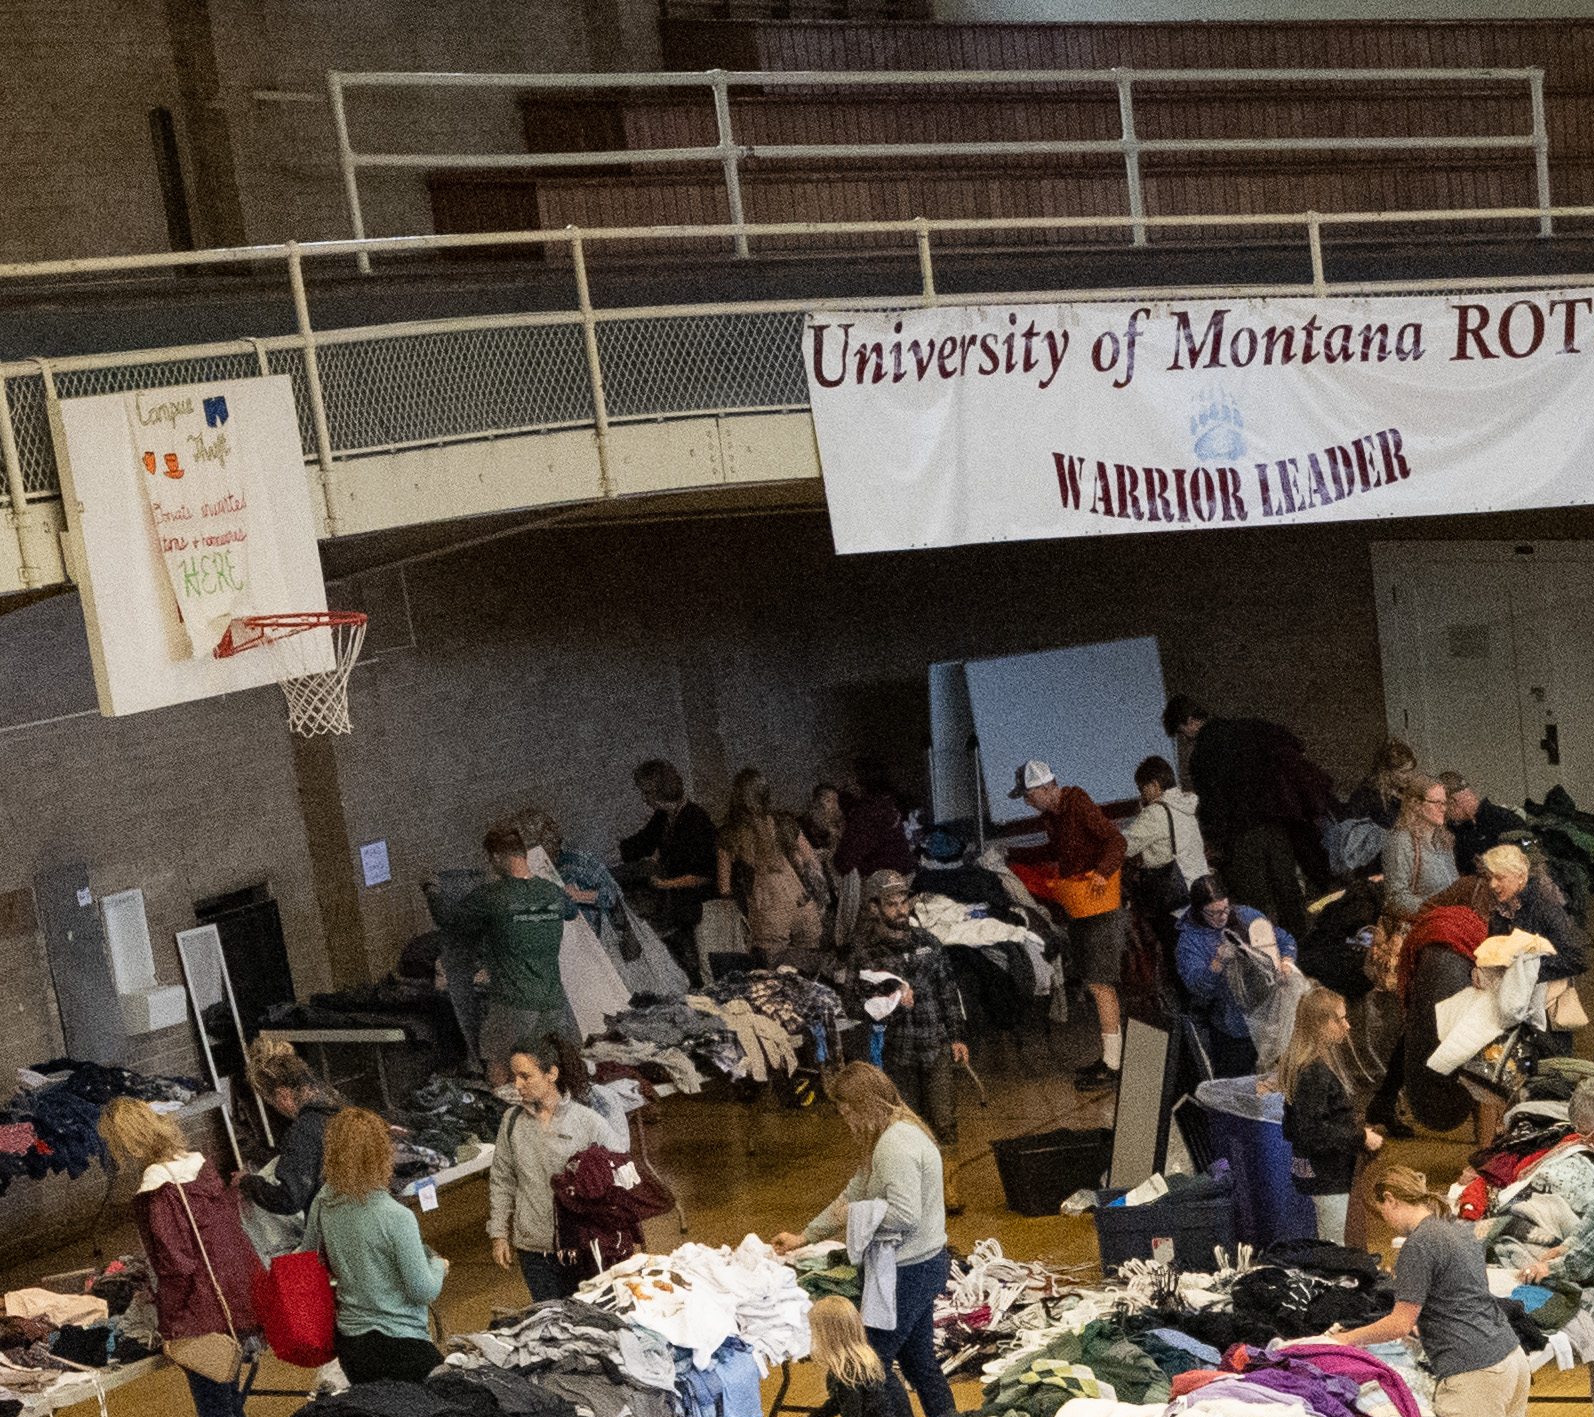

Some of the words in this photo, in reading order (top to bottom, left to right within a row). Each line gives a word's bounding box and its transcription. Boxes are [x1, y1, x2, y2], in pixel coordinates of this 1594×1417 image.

[808, 308, 1070, 390] University
[1092, 307, 1150, 389] of
[1167, 307, 1426, 371] Montana
[1052, 452, 1249, 523] WARRIOR
[1255, 427, 1413, 518] LEADER
